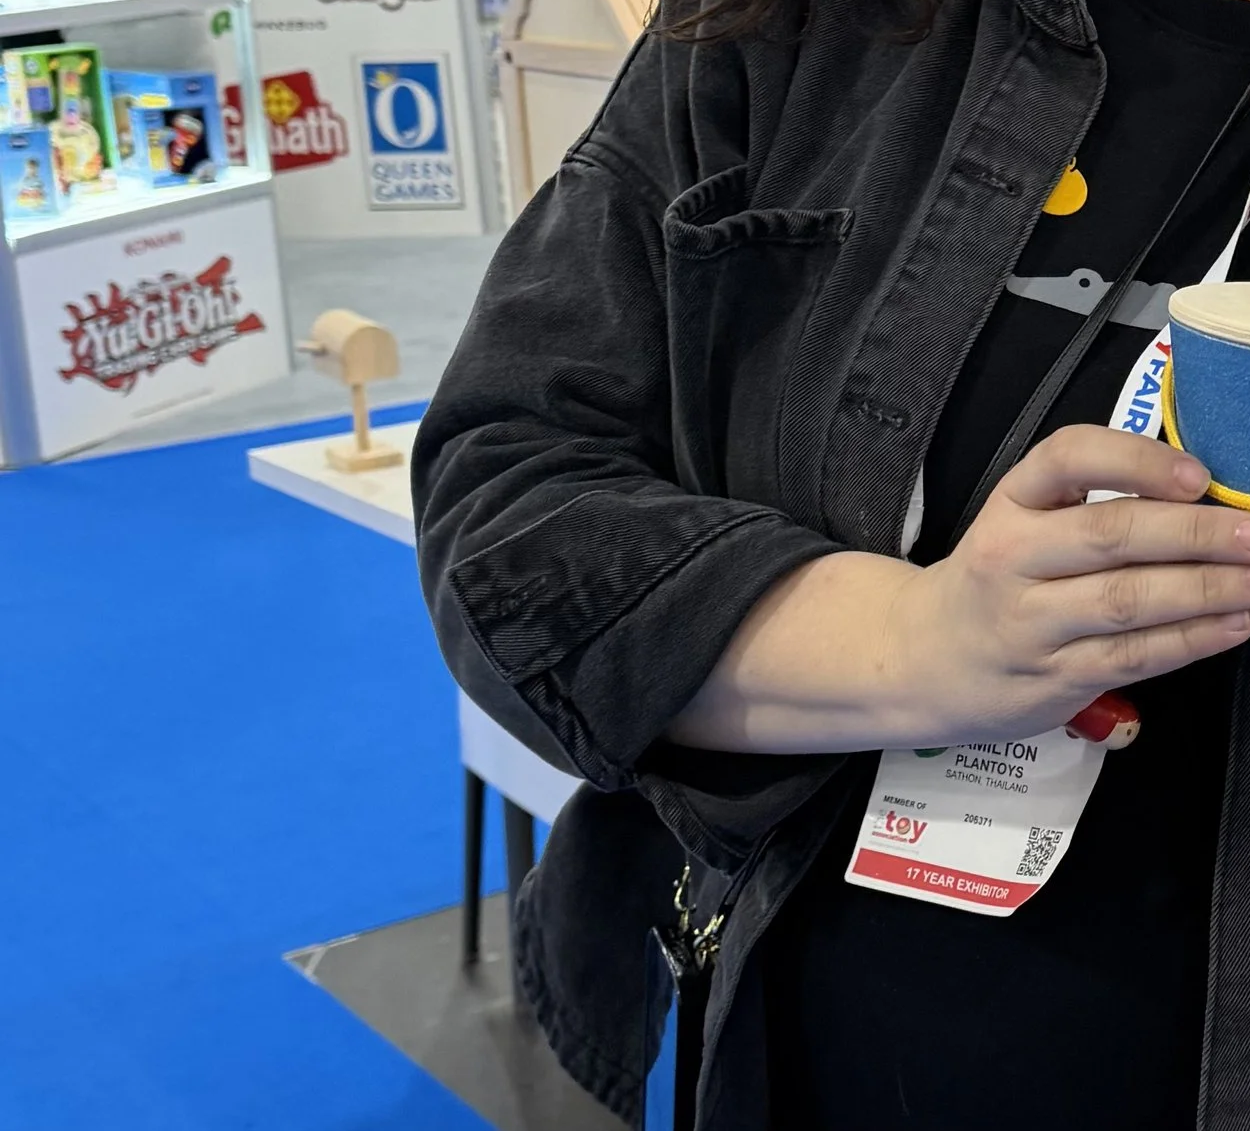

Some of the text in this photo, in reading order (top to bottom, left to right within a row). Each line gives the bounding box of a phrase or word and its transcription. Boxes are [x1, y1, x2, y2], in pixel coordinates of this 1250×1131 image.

[955, 754, 1024, 779] PLANTOYS
[985, 777, 1029, 794] THAILAND
[883, 795, 927, 810] MEMBER OF
[885, 810, 928, 844] toy
[906, 867, 1009, 900] 17 YEAR EXHIBITOR
